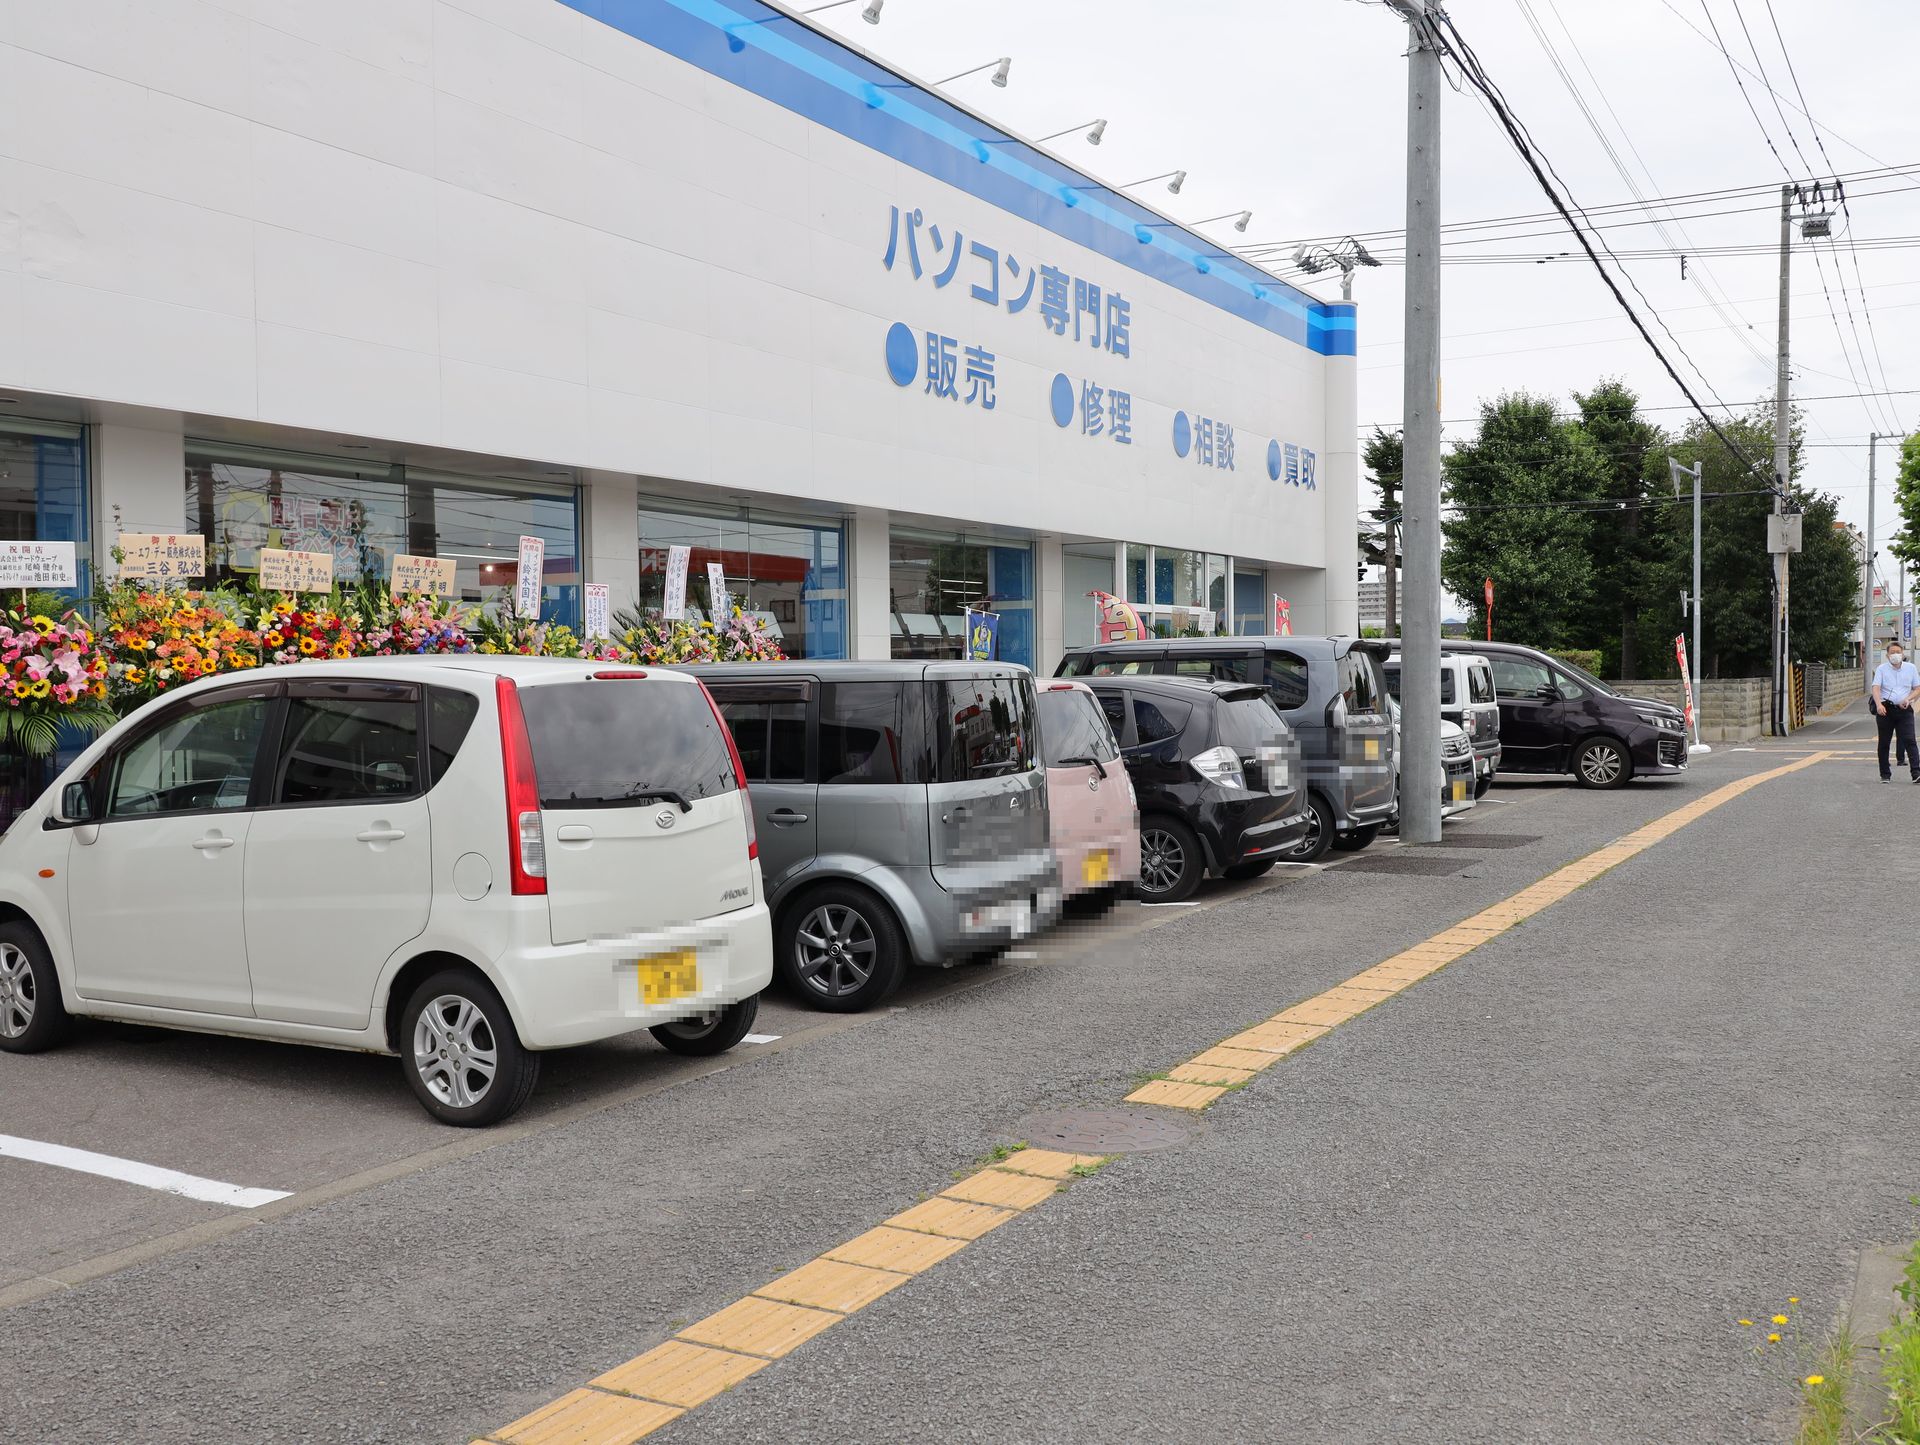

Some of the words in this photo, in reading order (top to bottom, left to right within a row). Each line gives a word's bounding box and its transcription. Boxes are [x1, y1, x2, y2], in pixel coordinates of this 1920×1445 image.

[882, 205, 1131, 359] パソコン専門店
[924, 331, 997, 410] 販売
[1079, 378, 1132, 444] 修理
[1193, 414, 1235, 472] 相談
[1283, 442, 1317, 491] 買取
[719, 886, 749, 902] MOVE
